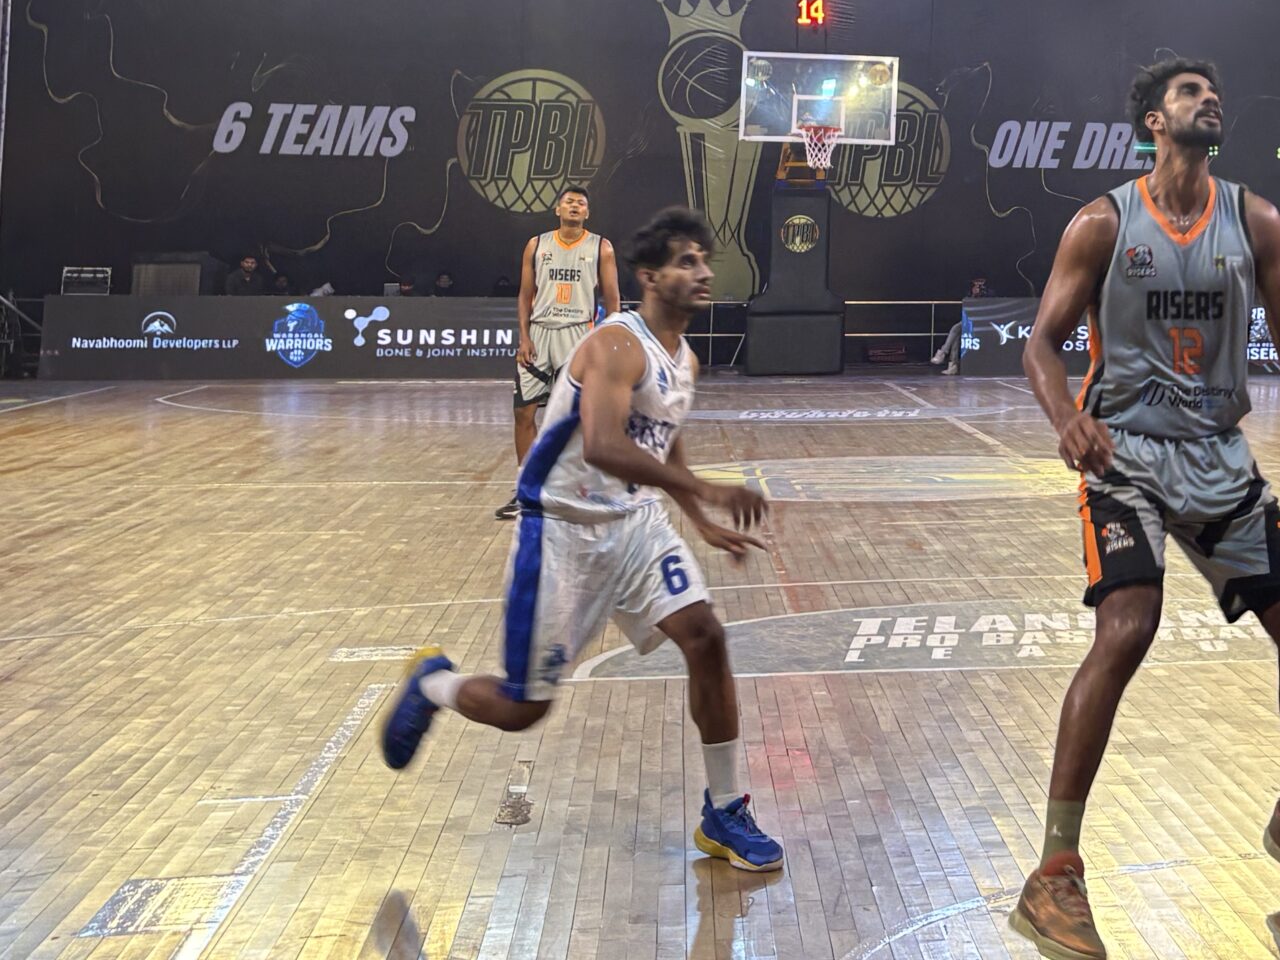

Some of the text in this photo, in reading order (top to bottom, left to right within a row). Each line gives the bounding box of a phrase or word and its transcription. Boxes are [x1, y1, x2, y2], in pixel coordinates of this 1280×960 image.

[797, 0, 825, 24] 14
[213, 101, 417, 157] 6 TEAMS
[468, 102, 600, 178] TPBL
[988, 120, 1156, 170] ONE DRE
[549, 268, 581, 282] RISERS
[1146, 290, 1224, 321] RISERS
[72, 337, 239, 351] Navabhoomi Developers LLP
[265, 338, 333, 352] WARRIORS
[376, 328, 514, 345] SUNSHIN
[376, 348, 412, 358] BONE
[427, 348, 463, 359] JOINT
[1168, 326, 1205, 375] 12
[660, 555, 690, 596] 6
[850, 633, 960, 649] PRO
